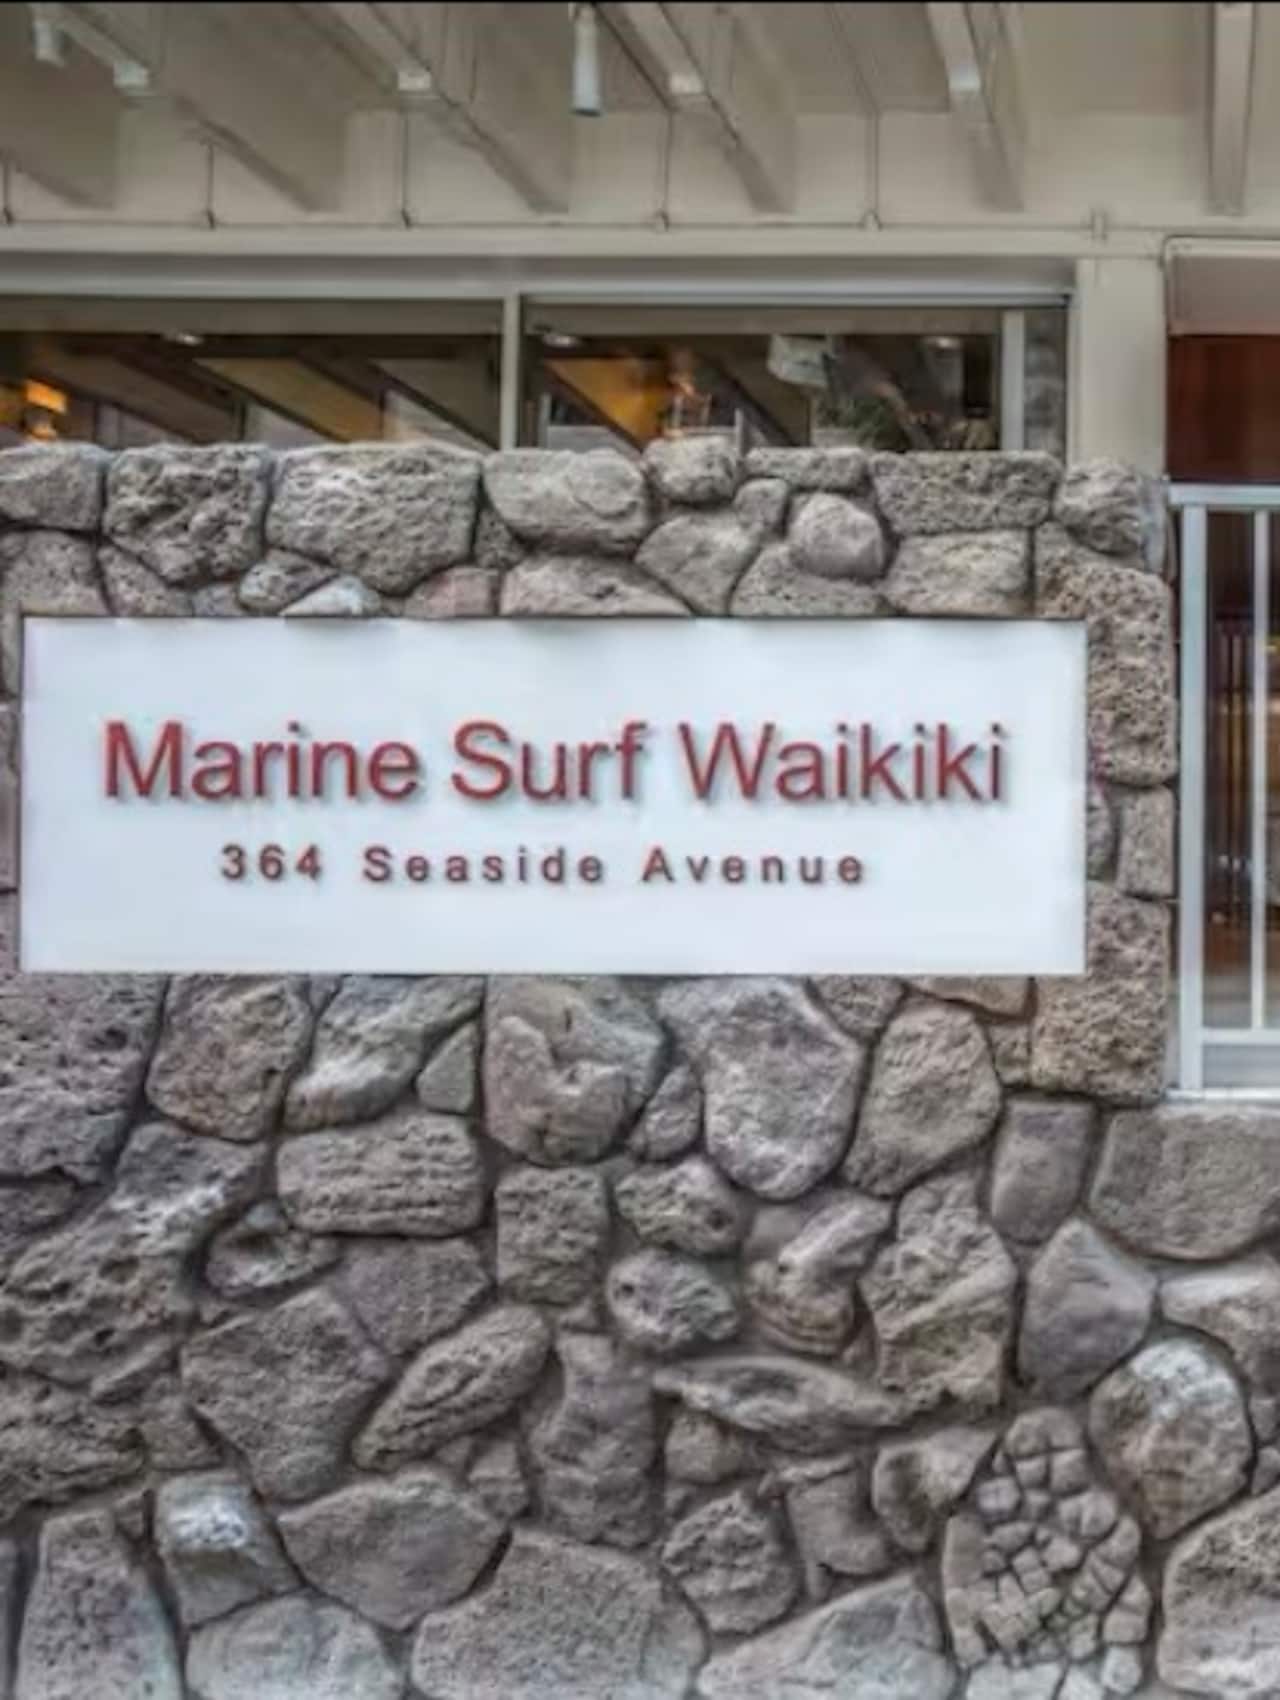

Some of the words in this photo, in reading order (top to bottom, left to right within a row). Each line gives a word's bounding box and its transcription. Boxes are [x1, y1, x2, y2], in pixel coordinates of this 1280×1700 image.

[104, 721, 421, 801] Marine
[451, 720, 645, 801] Surf
[678, 722, 1004, 801] Waikiki
[221, 845, 322, 881] 364
[363, 845, 604, 882] Seaside
[642, 846, 866, 883] Avenue
